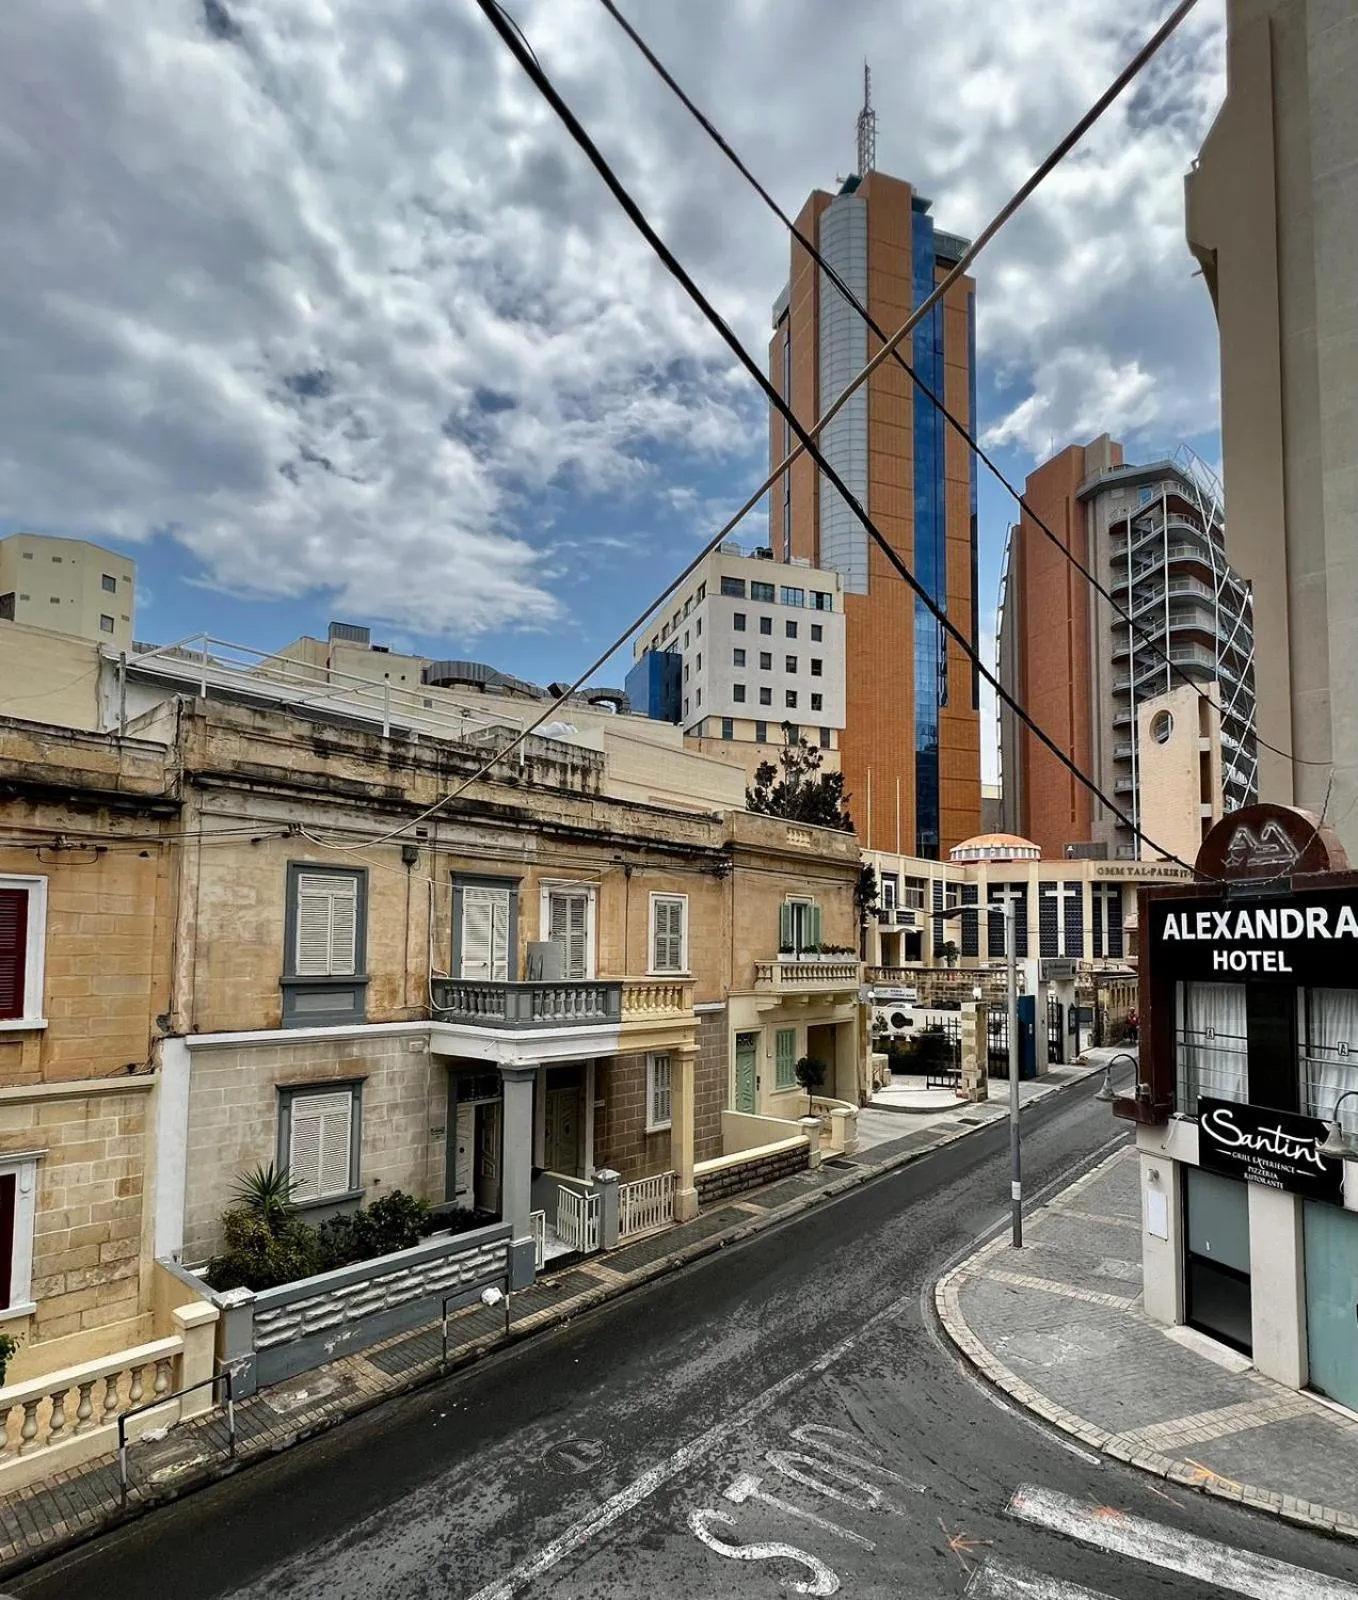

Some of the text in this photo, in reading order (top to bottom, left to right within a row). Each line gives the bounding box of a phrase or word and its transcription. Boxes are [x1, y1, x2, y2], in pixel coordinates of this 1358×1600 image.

[1162, 905, 1358, 941] ALEXANDRA
[1213, 950, 1293, 972] HOTEL
[1201, 1109, 1328, 1171] Santini
[1231, 1151, 1296, 1174] GRILL EXPERIENCE
[1247, 1165, 1279, 1180] PIZZERIA
[1243, 1172, 1285, 1190] RISTORANTE
[686, 1423, 928, 1597] STOP
